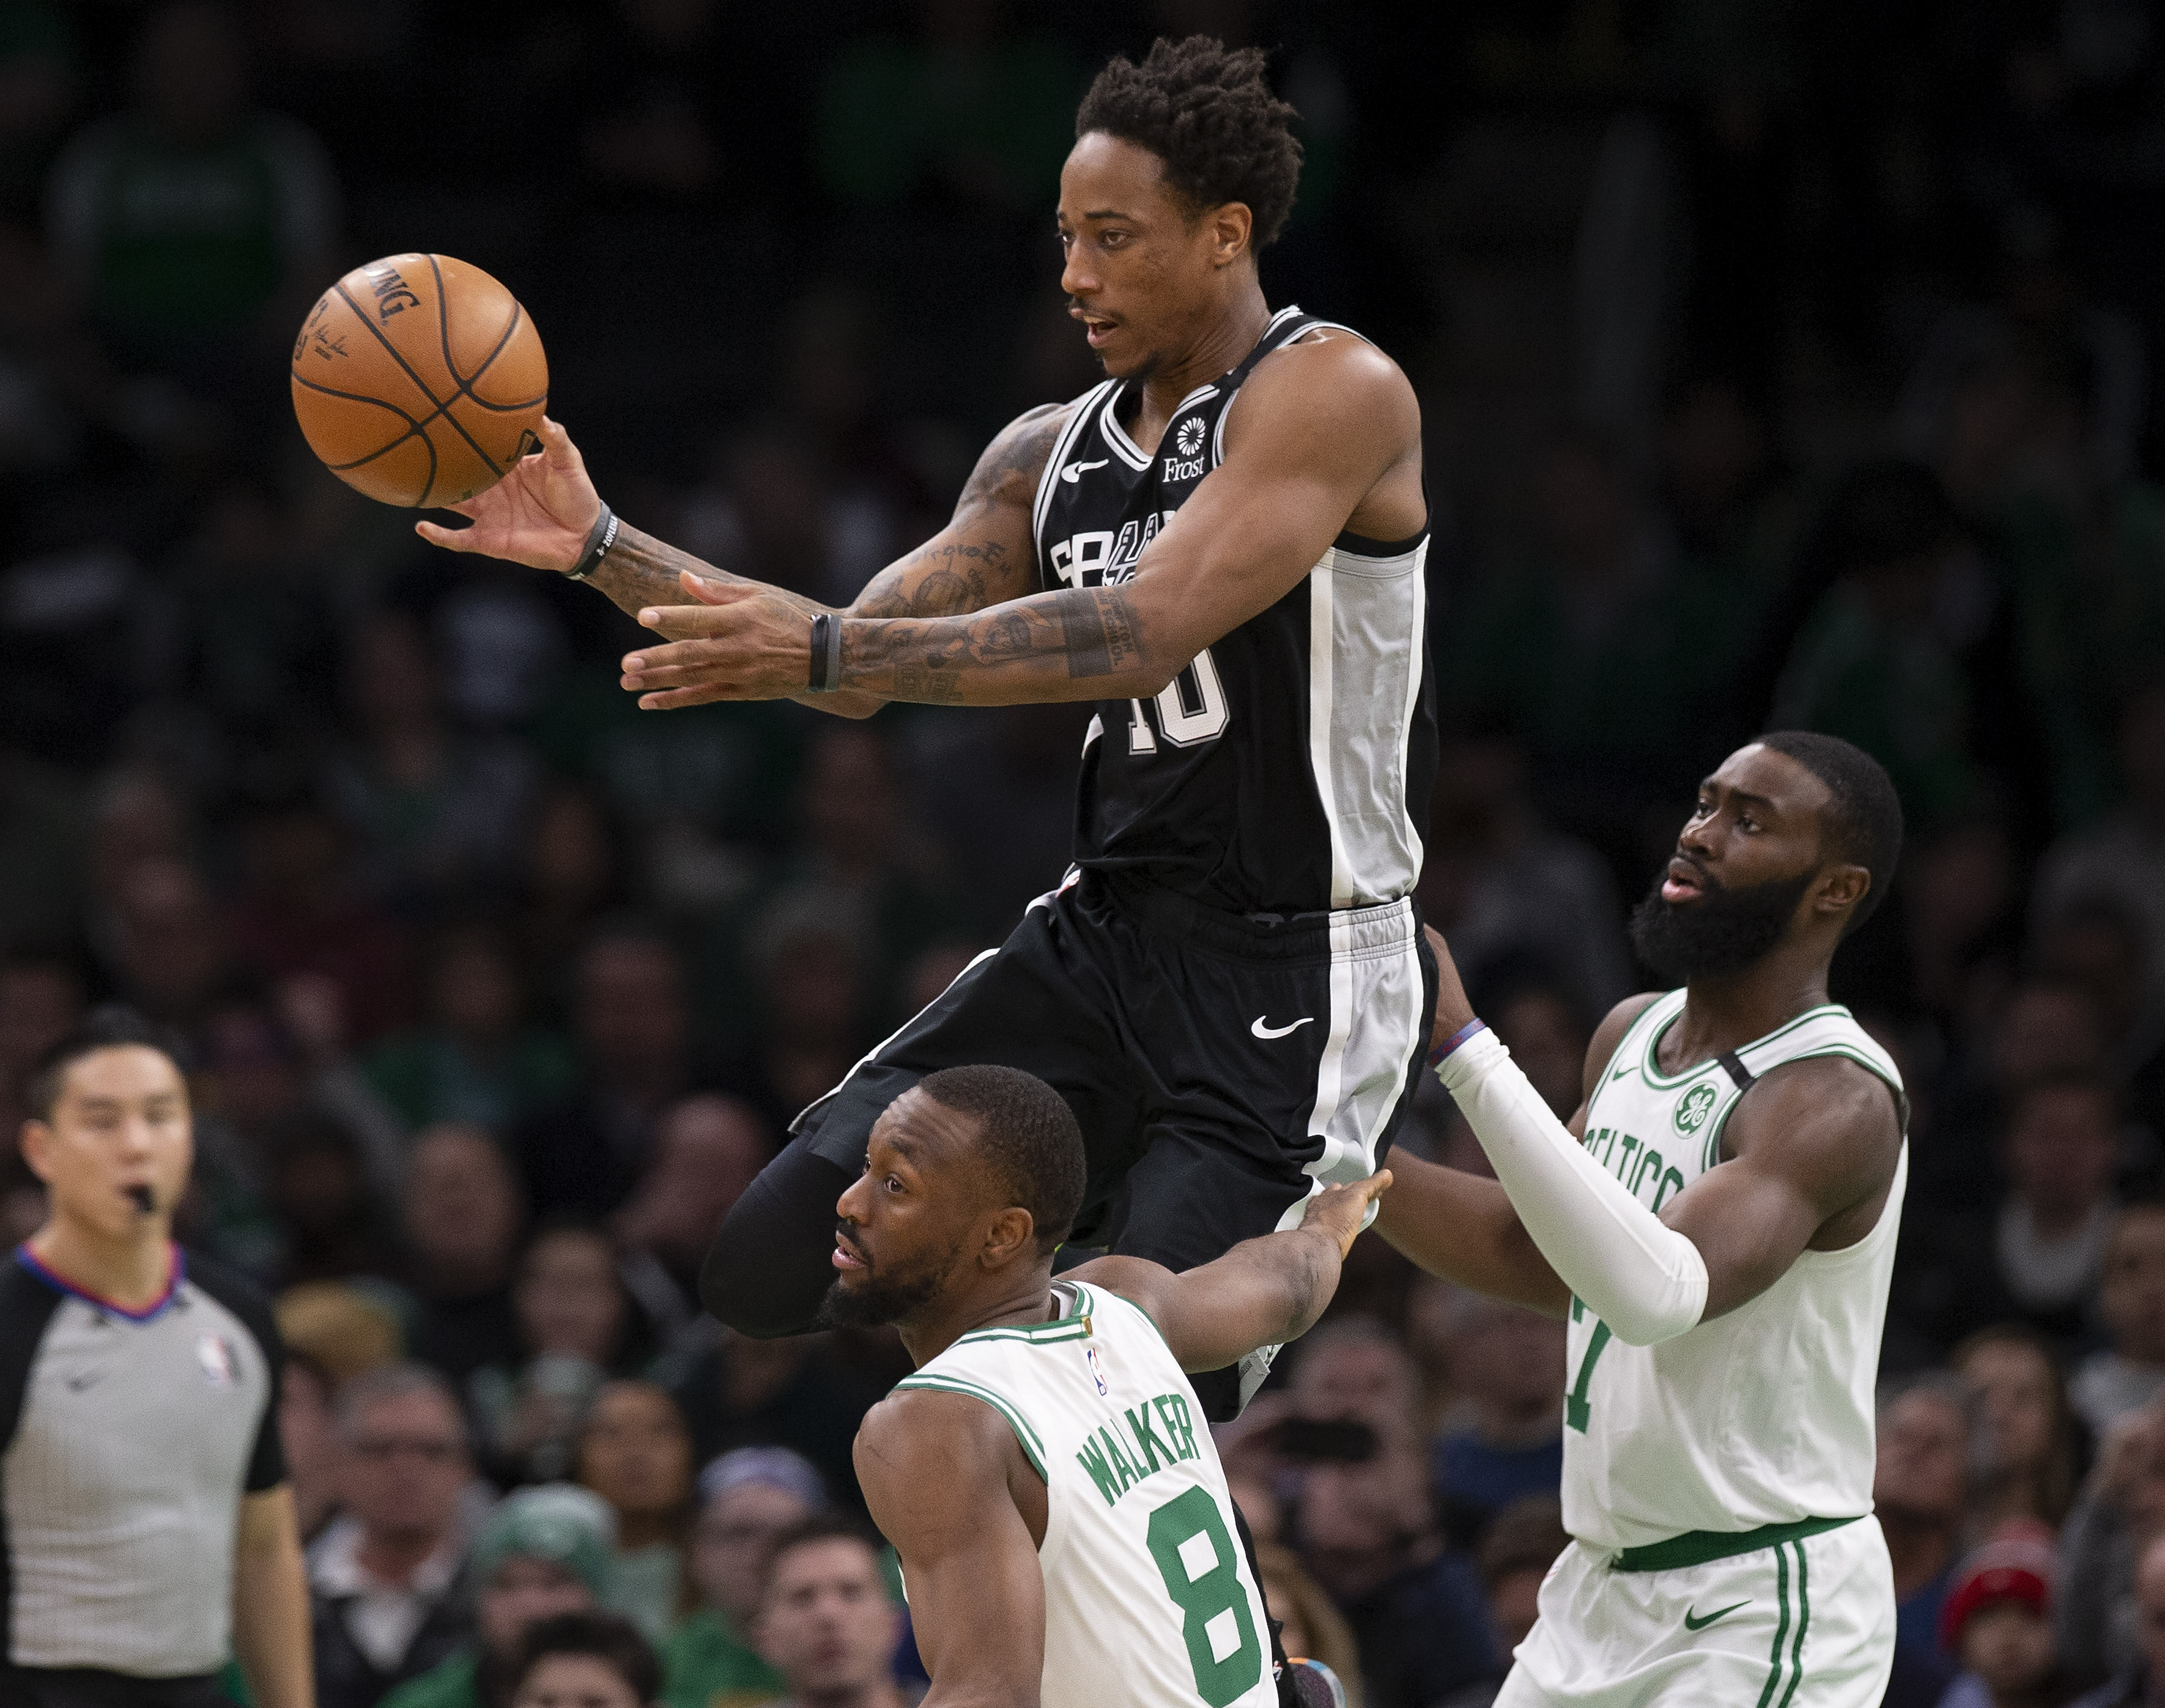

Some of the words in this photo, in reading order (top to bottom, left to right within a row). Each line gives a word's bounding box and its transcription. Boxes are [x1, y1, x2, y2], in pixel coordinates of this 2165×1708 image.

[1163, 455, 1205, 483] Frost
[1566, 1293, 1612, 1434] 7
[1076, 1394, 1201, 1508] WALKER
[1146, 1484, 1262, 1708] 8
